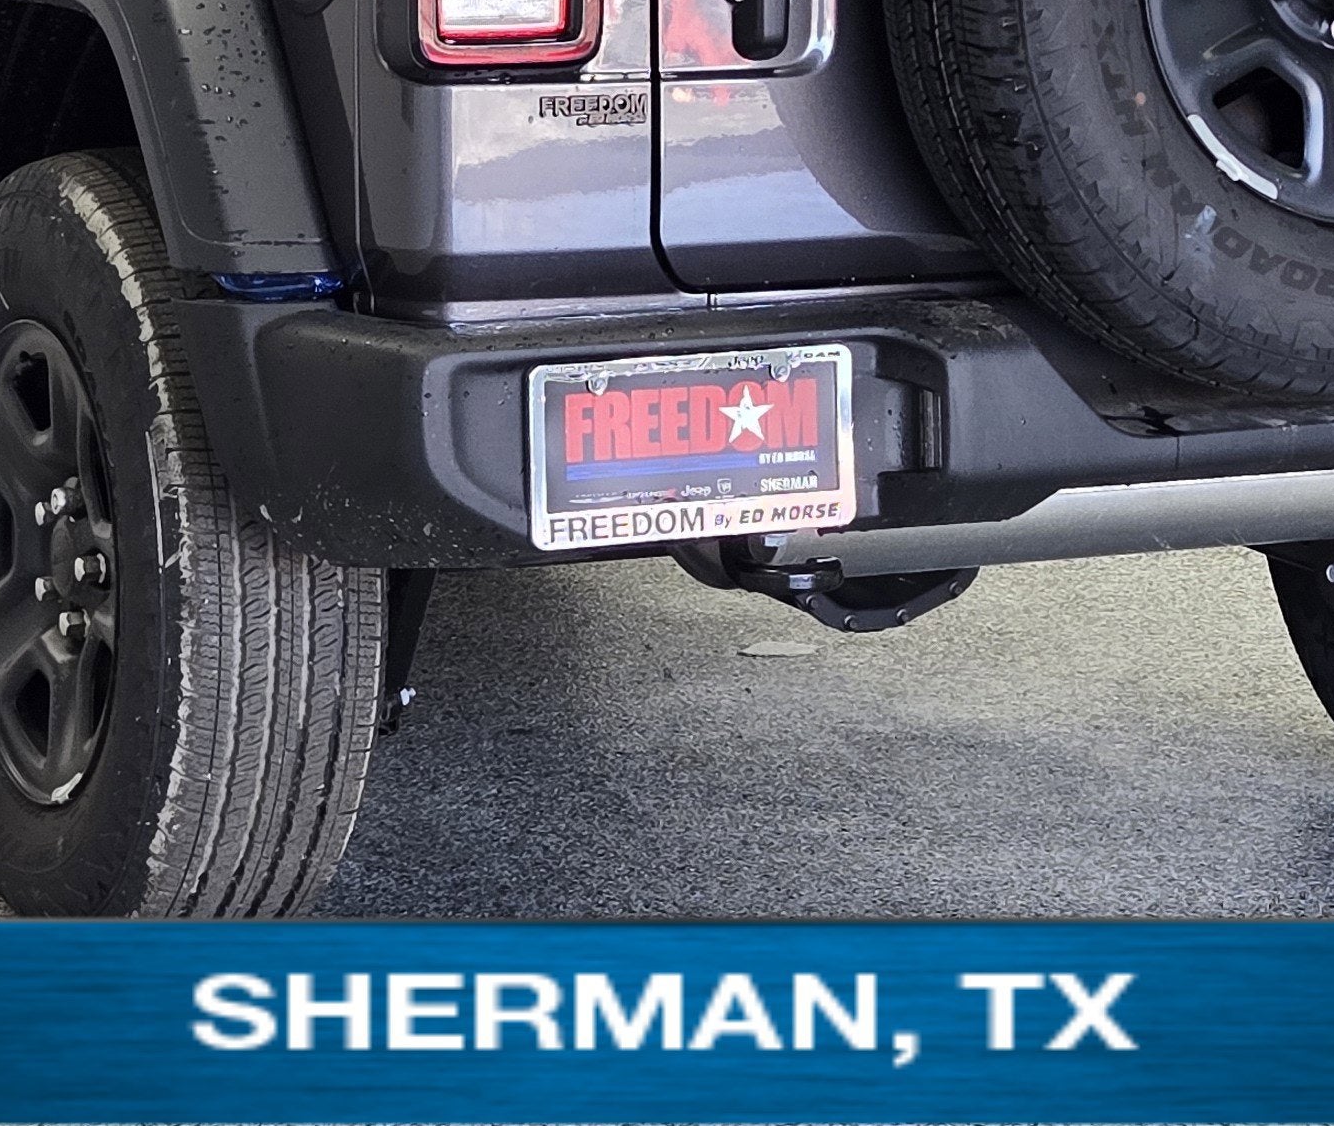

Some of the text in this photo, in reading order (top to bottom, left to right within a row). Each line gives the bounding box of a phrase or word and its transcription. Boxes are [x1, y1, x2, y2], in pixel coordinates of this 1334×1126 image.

[539, 93, 648, 117] FREEDOM
[564, 378, 818, 463] FREEDOM
[680, 484, 712, 497] Jeep
[760, 475, 818, 493] SHERMAN
[548, 506, 705, 544] FREEDOM
[739, 509, 765, 525] ED
[771, 502, 840, 523] MORSE
